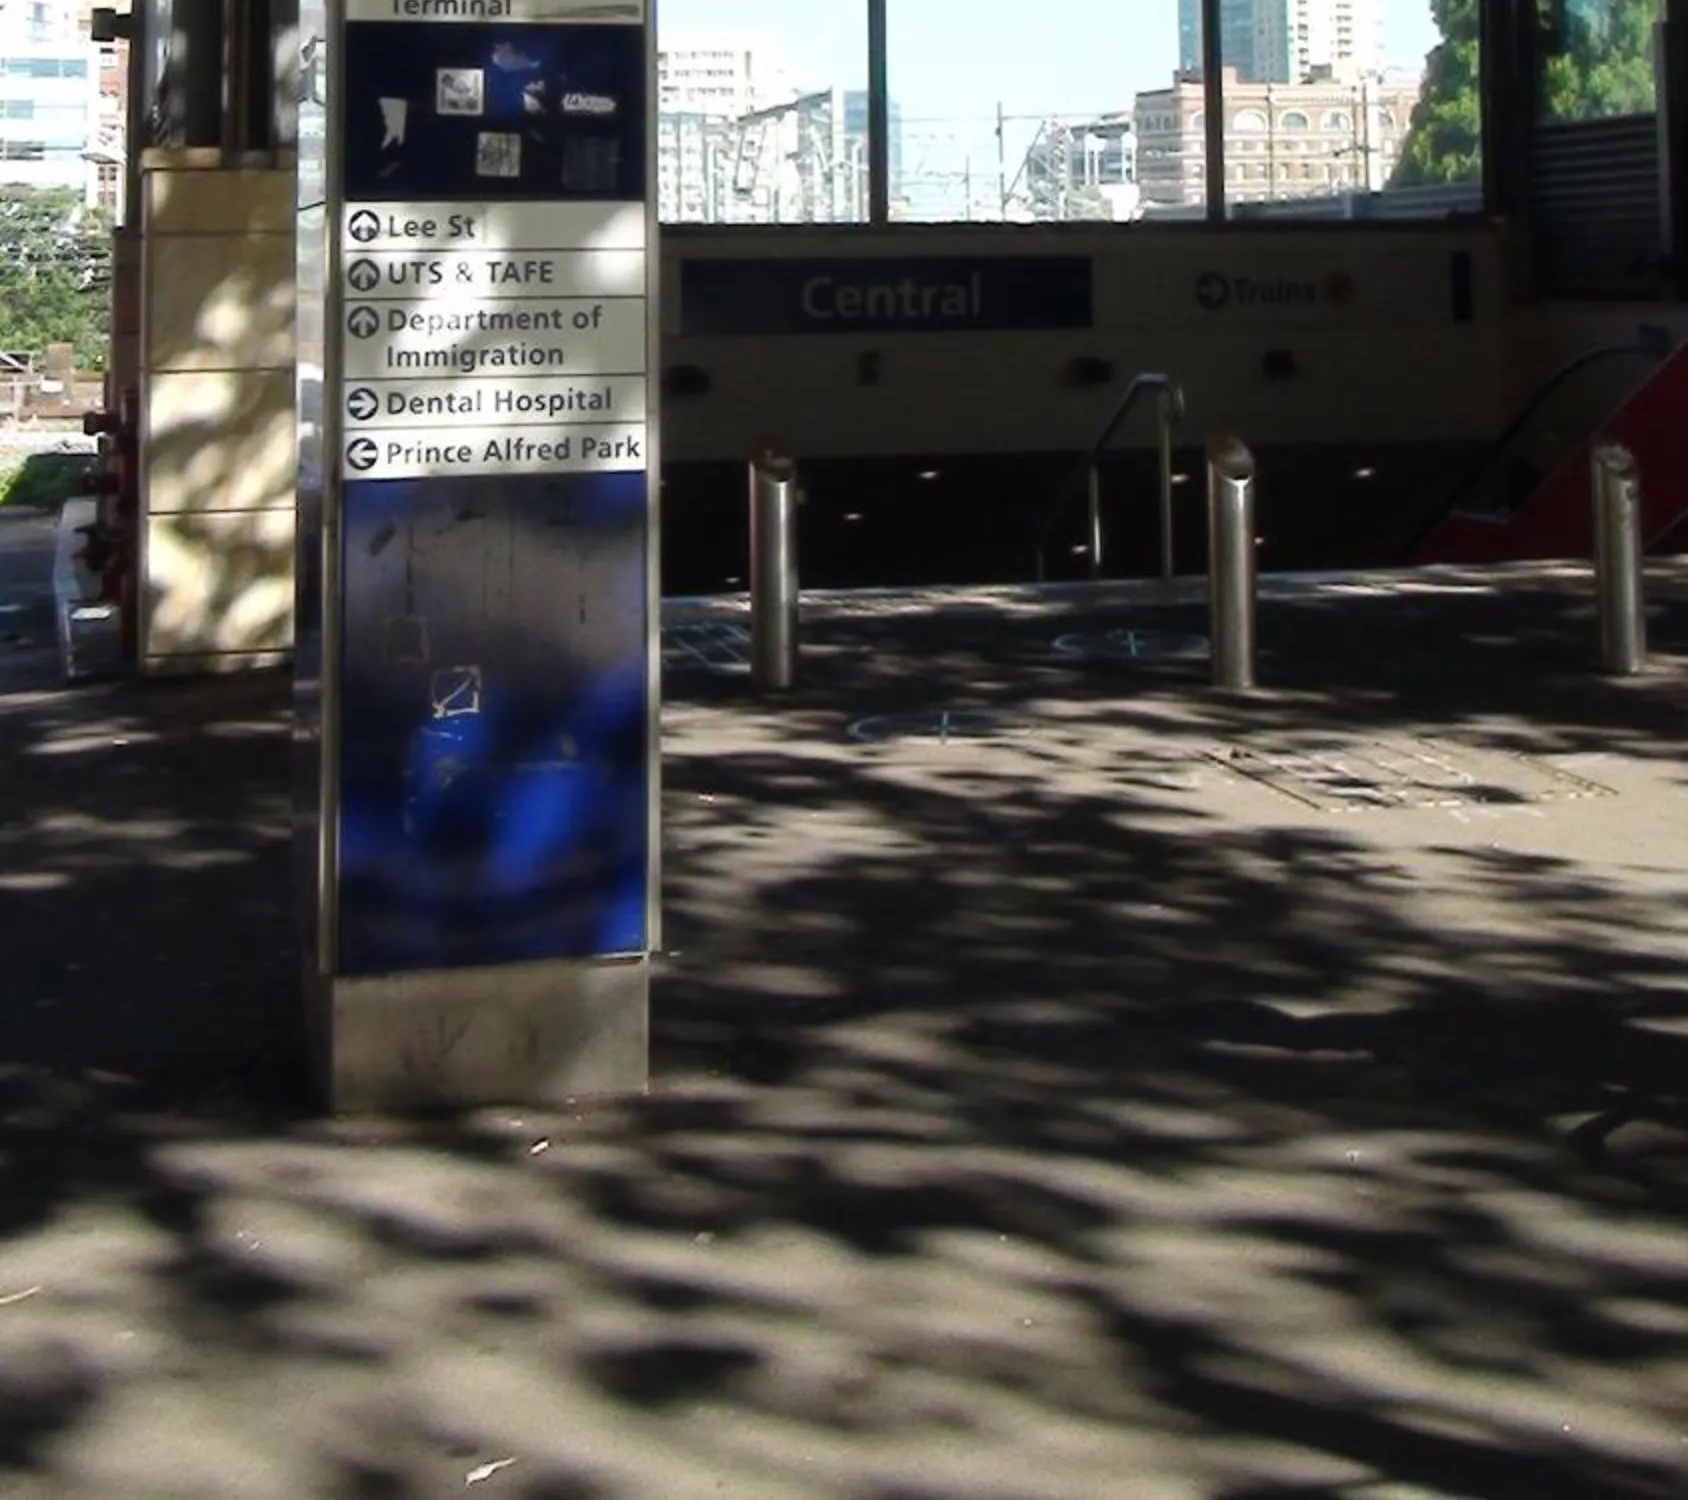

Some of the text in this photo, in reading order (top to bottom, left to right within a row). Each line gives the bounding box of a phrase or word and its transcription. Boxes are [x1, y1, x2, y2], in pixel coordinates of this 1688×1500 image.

[388, 215, 475, 237] Lee St
[388, 261, 554, 284] UTS & TAFE
[802, 272, 982, 321] Central
[1232, 276, 1316, 304] Trains
[387, 305, 603, 335] Department of
[387, 342, 563, 372] Immigration
[387, 387, 612, 416] Dental Hospital
[387, 435, 640, 465] Prince Alfred Park
